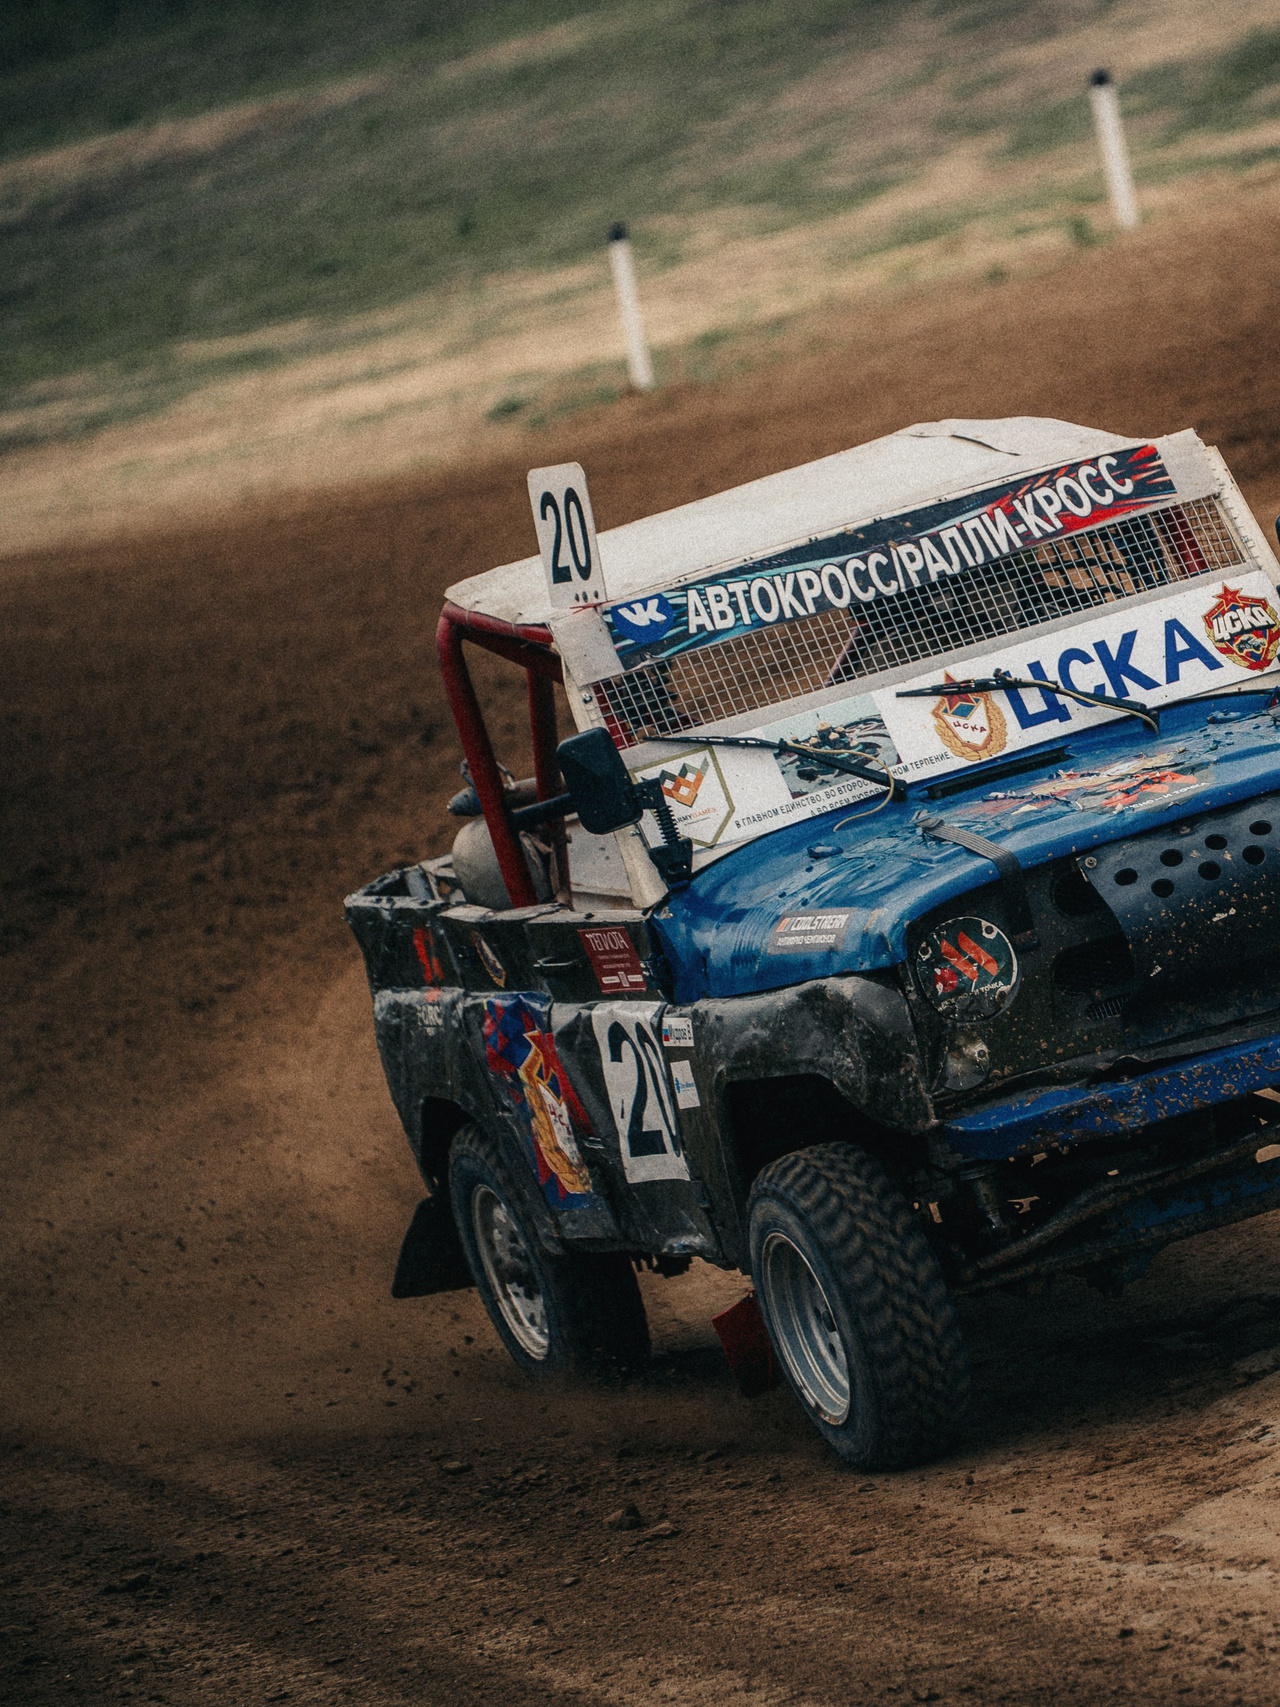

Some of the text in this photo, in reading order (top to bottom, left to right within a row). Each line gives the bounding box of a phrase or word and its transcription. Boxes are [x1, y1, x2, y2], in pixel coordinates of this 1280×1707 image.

[540, 487, 592, 584] 20
[1211, 606, 1276, 641] ЦСКА
[1001, 617, 1224, 730] ЦСКА
[953, 720, 987, 733] ЦСКА
[735, 820, 741, 829] В
[742, 807, 779, 826] ГЛАВНОМ
[780, 794, 825, 815] ЕДИНСТВО,
[825, 789, 837, 800] ВО
[910, 751, 953, 771] ТЕРПЕНИЕ,
